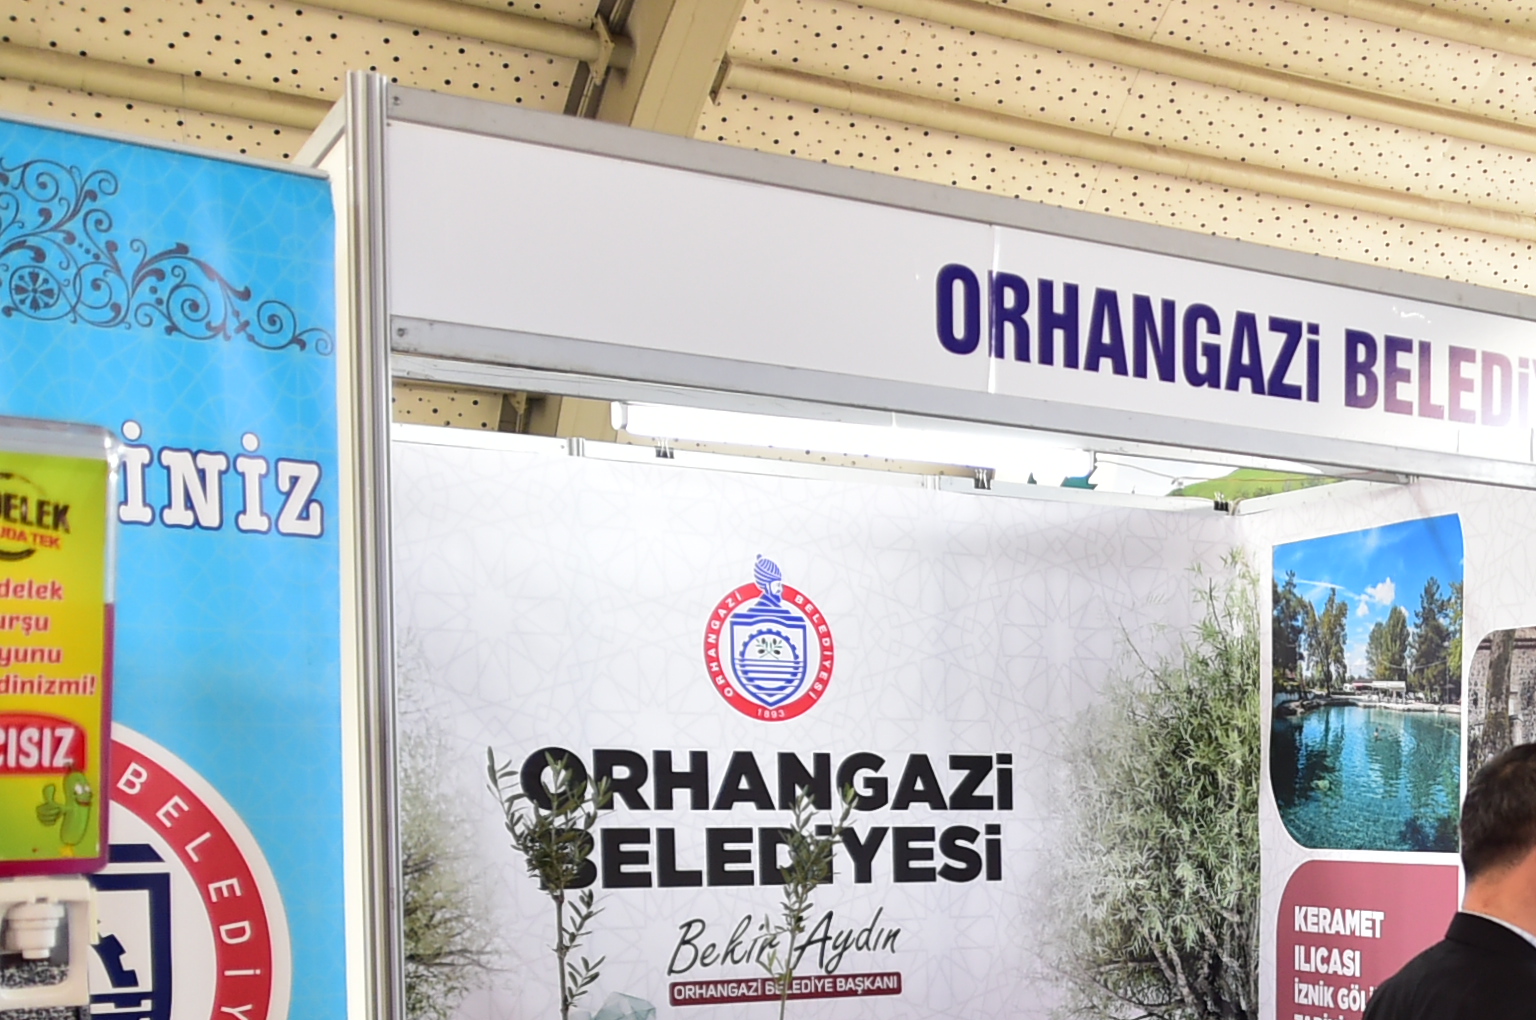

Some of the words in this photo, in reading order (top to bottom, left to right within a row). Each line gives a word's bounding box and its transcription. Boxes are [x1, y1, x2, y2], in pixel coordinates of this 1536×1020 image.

[0, 491, 71, 535] ELEK
[757, 708, 785, 719] 1893
[1294, 905, 1385, 939] KERAMET
[667, 914, 780, 976] Bekir
[792, 906, 901, 974] Aydın
[1294, 944, 1362, 978] ILICASI
[674, 978, 762, 1000] ORHANGAZİ
[836, 975, 898, 995] BAŞKANI
[1294, 978, 1335, 1009] İZNİK
[1337, 983, 1378, 1012] GÖL
